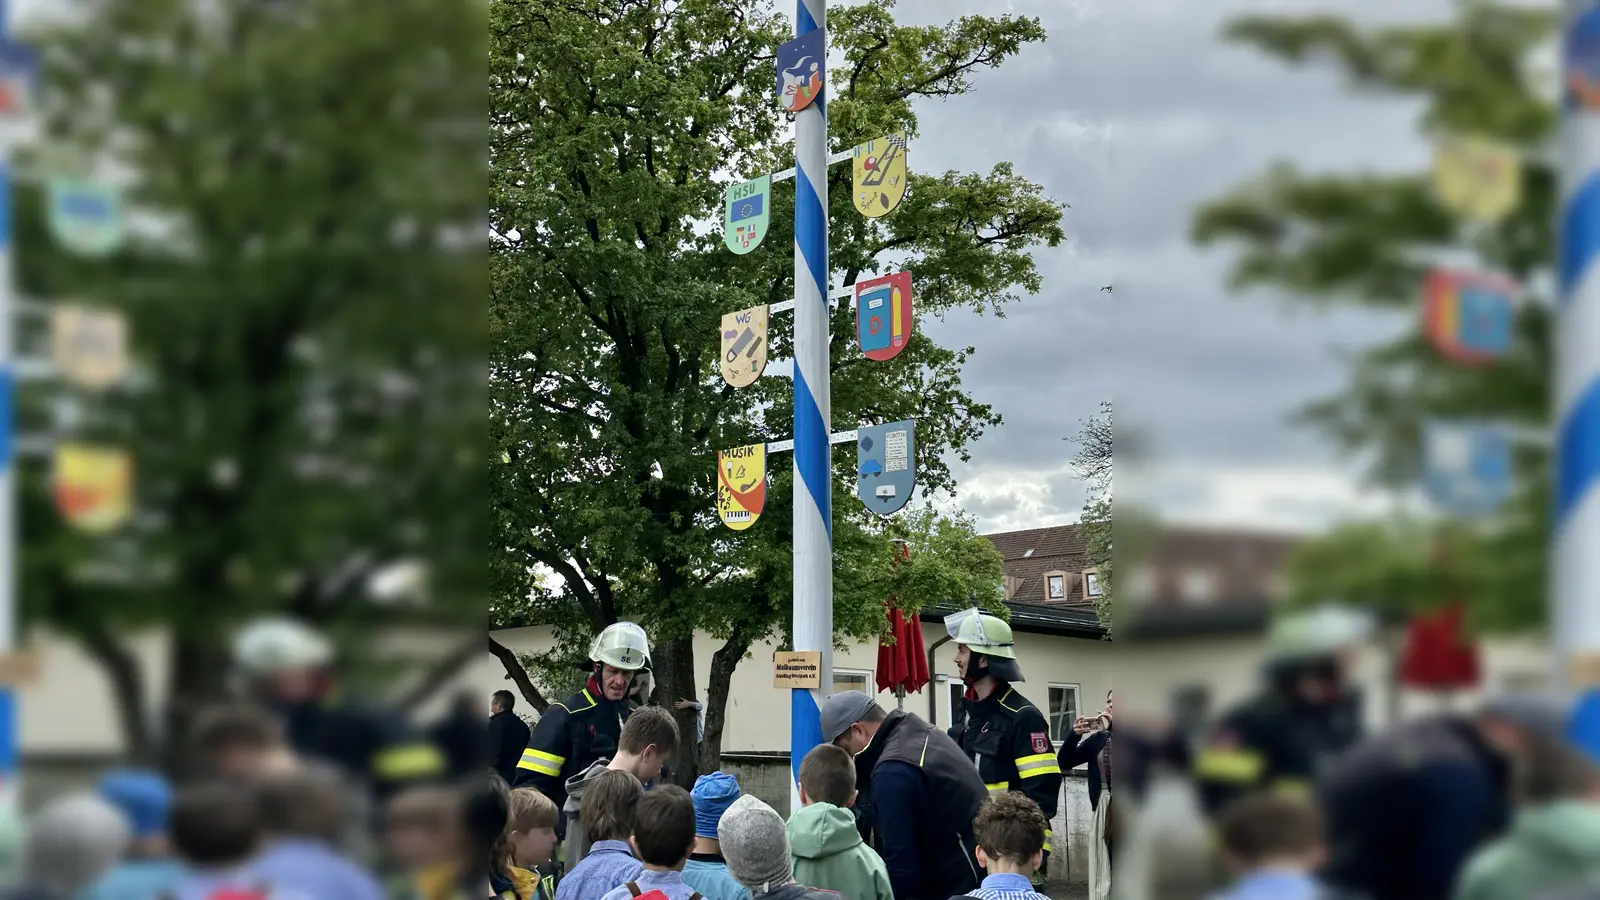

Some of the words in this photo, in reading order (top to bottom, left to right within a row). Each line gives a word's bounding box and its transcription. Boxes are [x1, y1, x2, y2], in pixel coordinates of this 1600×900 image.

[734, 183, 755, 200] HSU
[735, 312, 752, 324] WG
[870, 315, 882, 335] D
[722, 446, 754, 459] MUSIK
